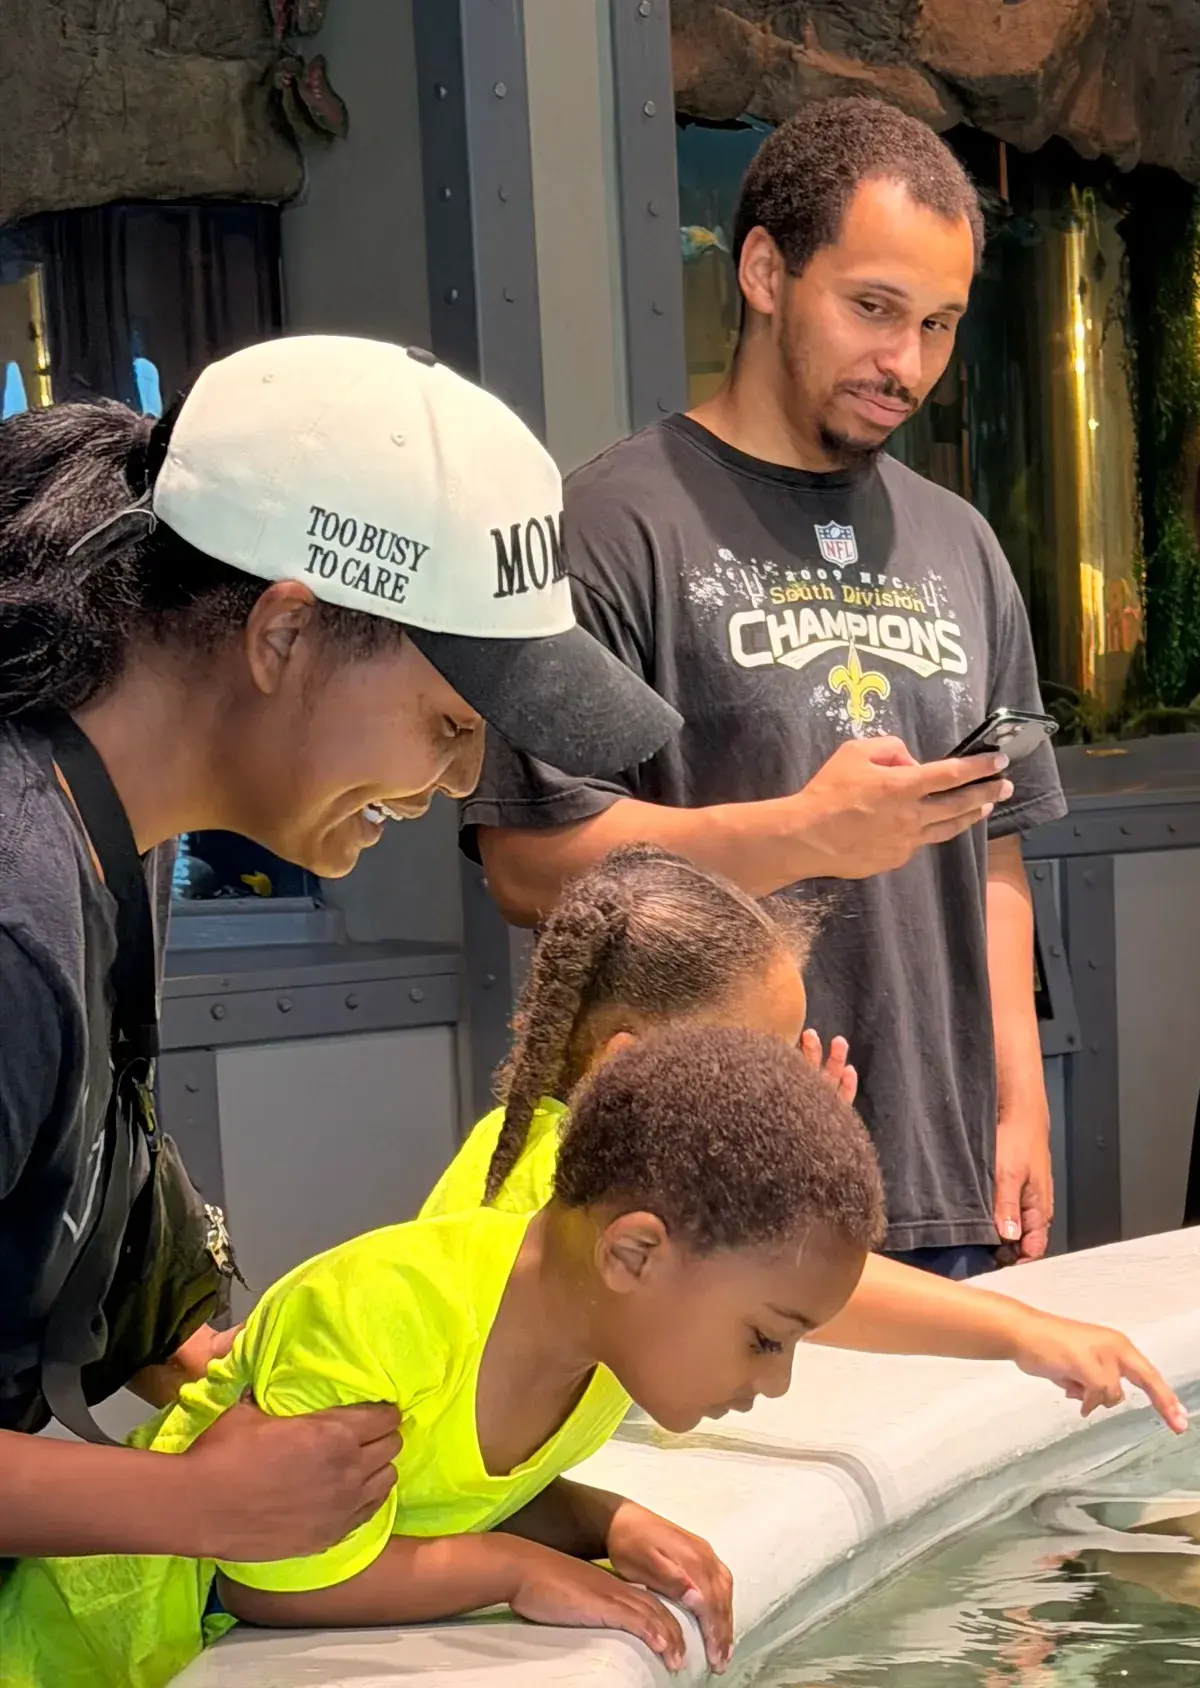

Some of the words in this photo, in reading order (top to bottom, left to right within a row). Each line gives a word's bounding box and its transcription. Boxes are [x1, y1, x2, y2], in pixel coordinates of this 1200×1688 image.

[306, 505, 357, 547] TOO
[356, 523, 430, 572] BUSY
[825, 541, 853, 561] NFL
[304, 543, 338, 579] TO
[341, 557, 410, 604] CARE
[785, 568, 843, 582] 2009
[860, 572, 903, 586] NFC
[769, 583, 835, 605] South
[843, 585, 926, 613] Division
[729, 608, 967, 674] CHAMPIONS
